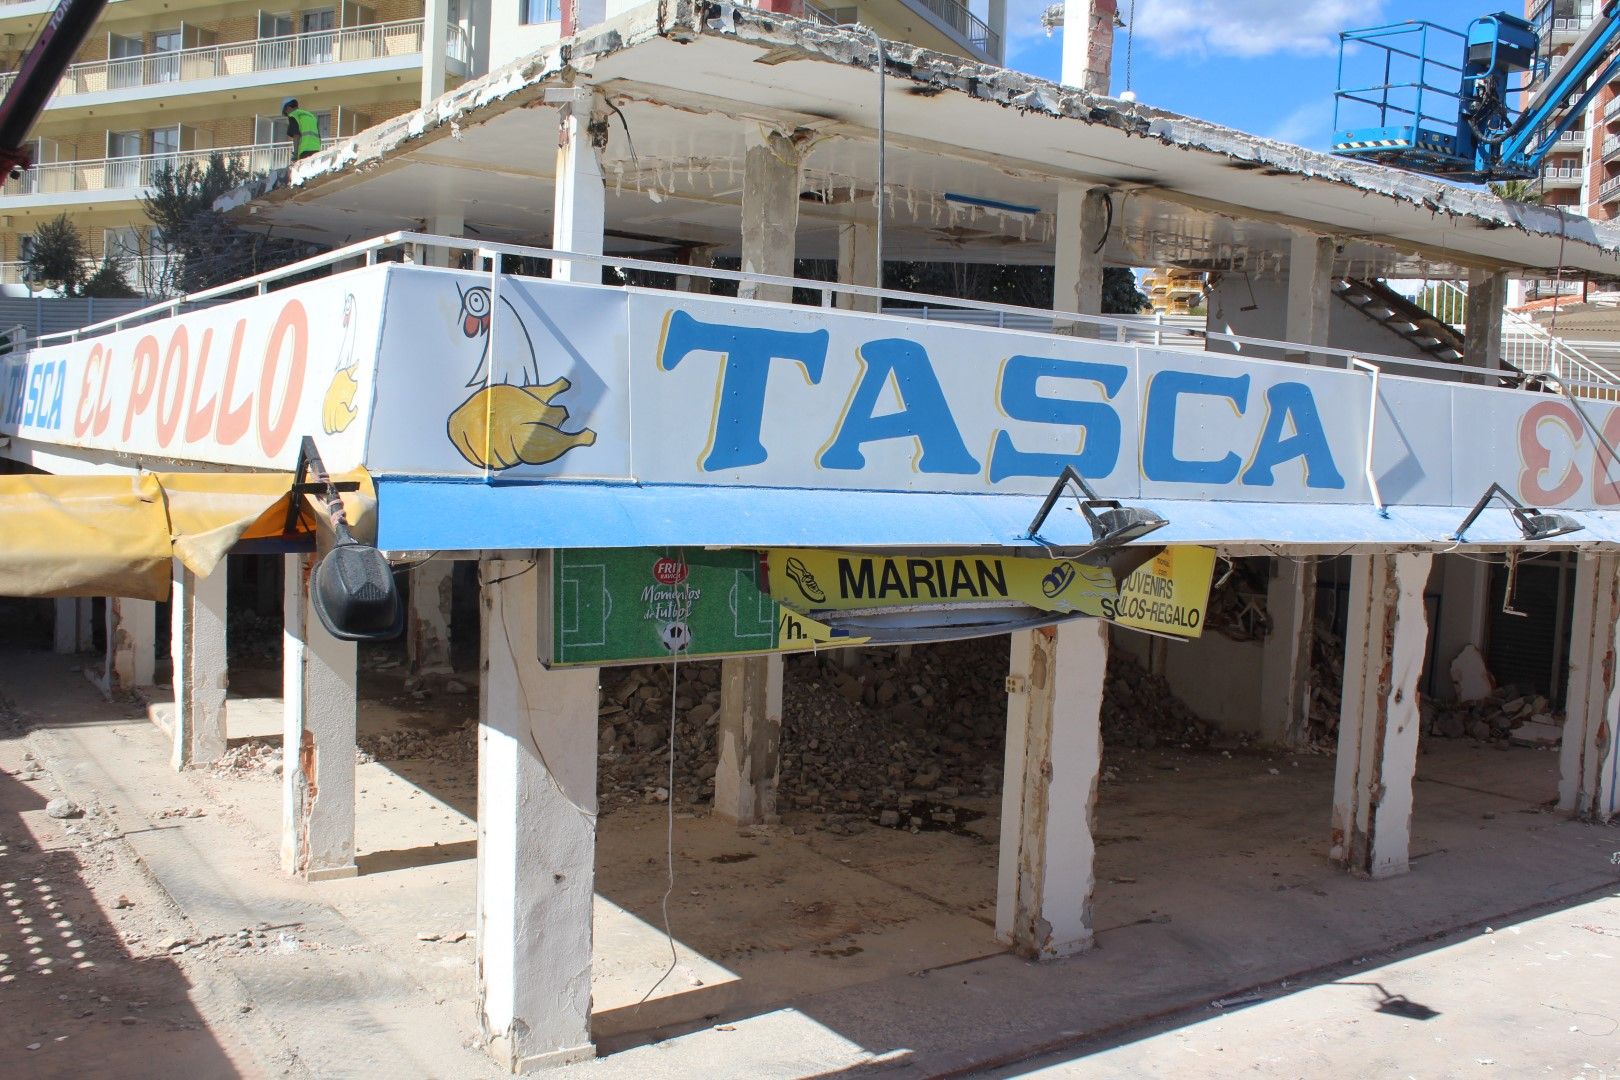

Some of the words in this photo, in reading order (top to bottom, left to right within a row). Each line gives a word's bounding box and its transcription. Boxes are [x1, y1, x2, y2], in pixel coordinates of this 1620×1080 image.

[5, 360, 67, 429] TASCA
[74, 342, 112, 438] EL
[122, 299, 309, 458] POLLO
[656, 309, 1345, 490] TASCA
[838, 558, 1008, 599] MARIAN
